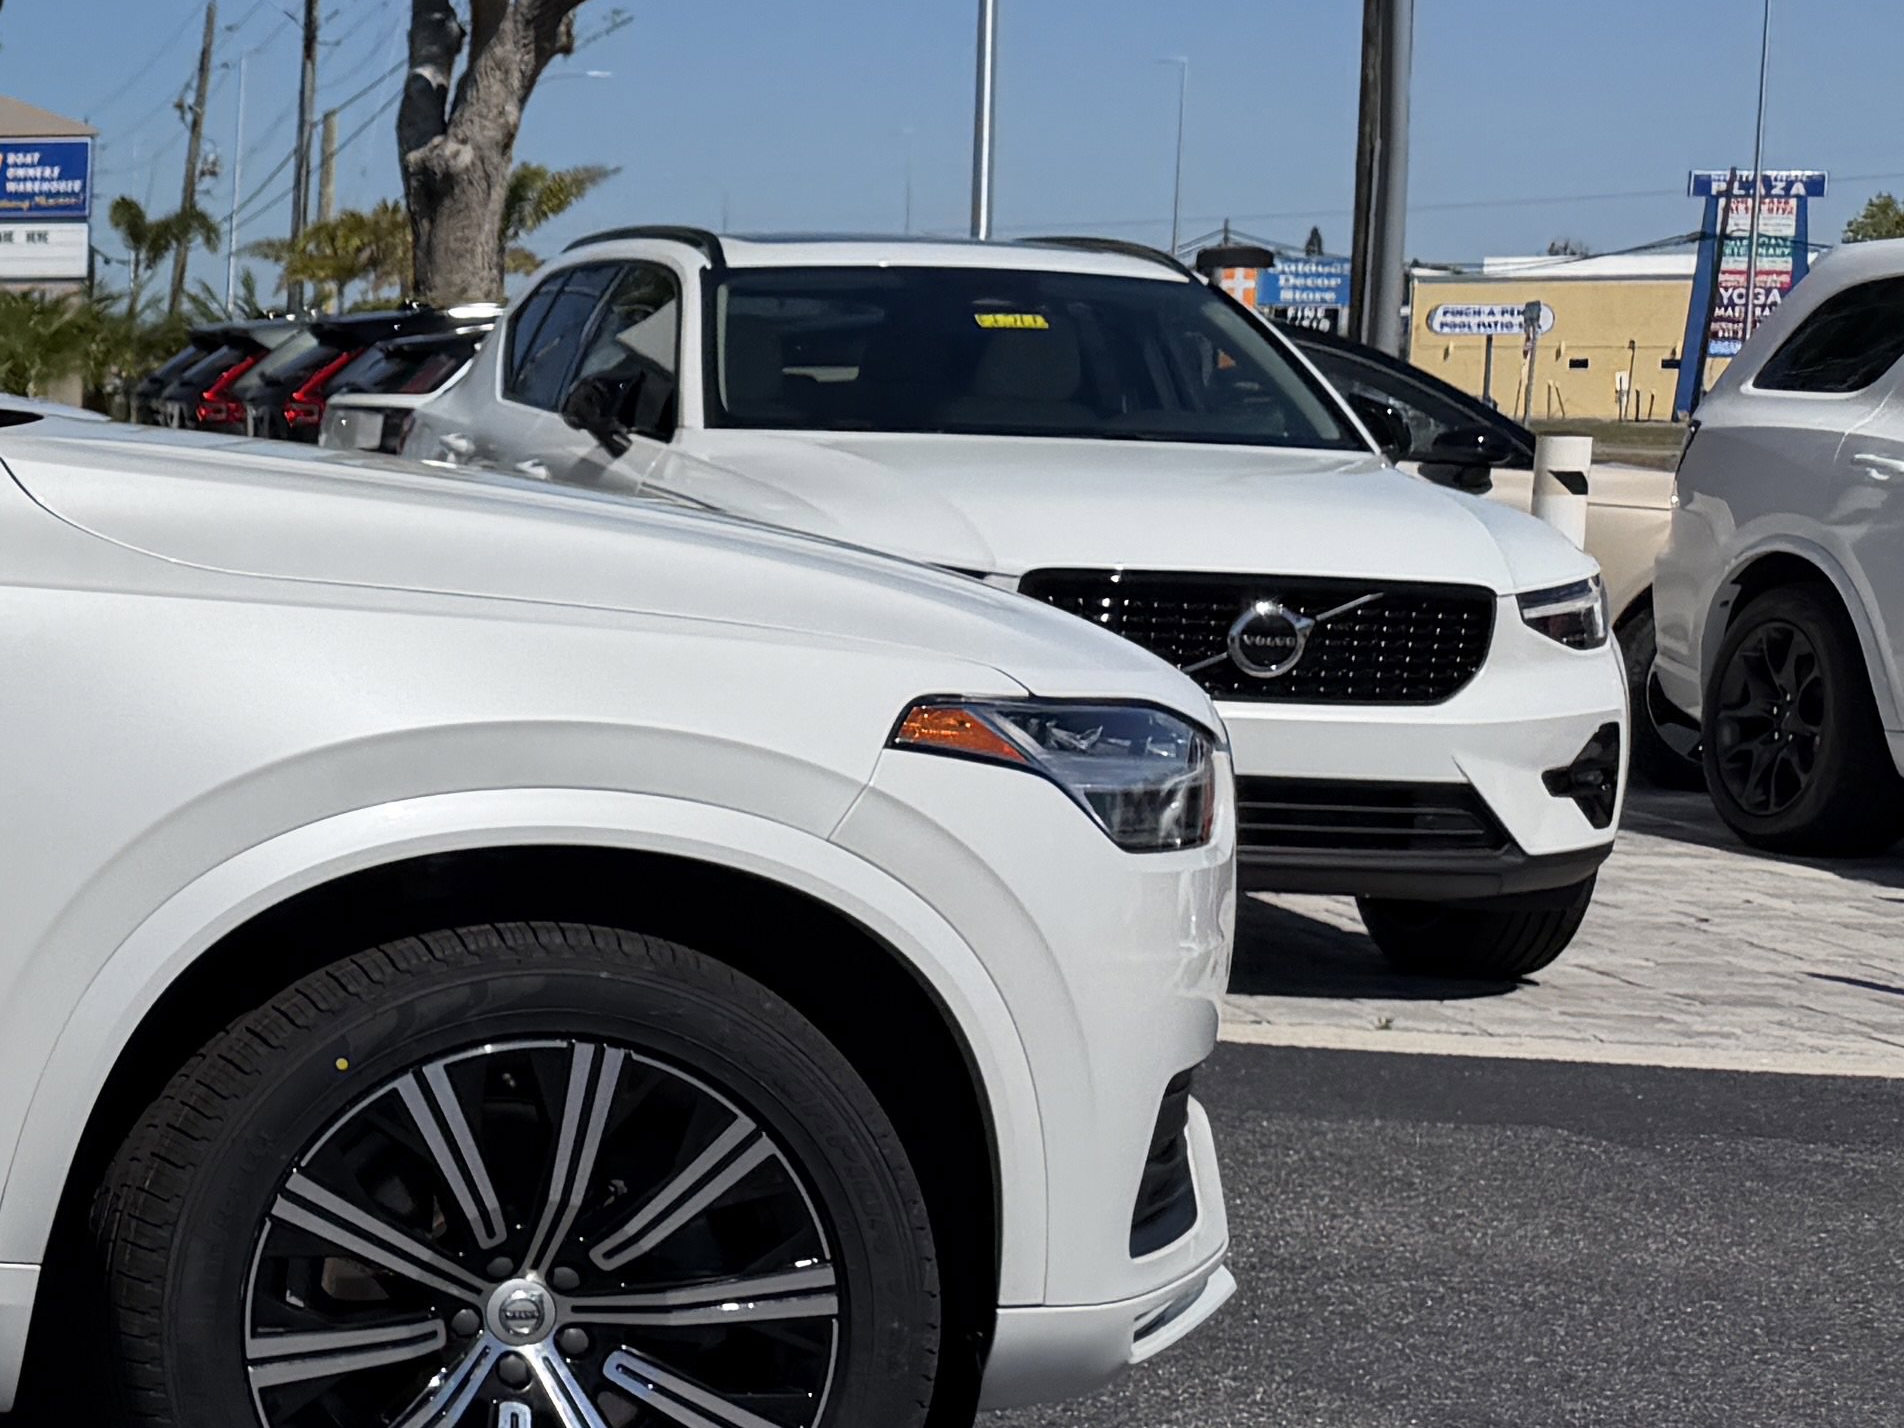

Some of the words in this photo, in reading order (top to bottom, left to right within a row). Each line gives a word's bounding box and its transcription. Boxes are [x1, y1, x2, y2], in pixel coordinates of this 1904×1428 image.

[6, 152, 40, 165] BOAT
[6, 166, 61, 179] OWNERS
[6, 180, 82, 193] WAREHOUSE
[1243, 634, 1296, 647] VOLVO
